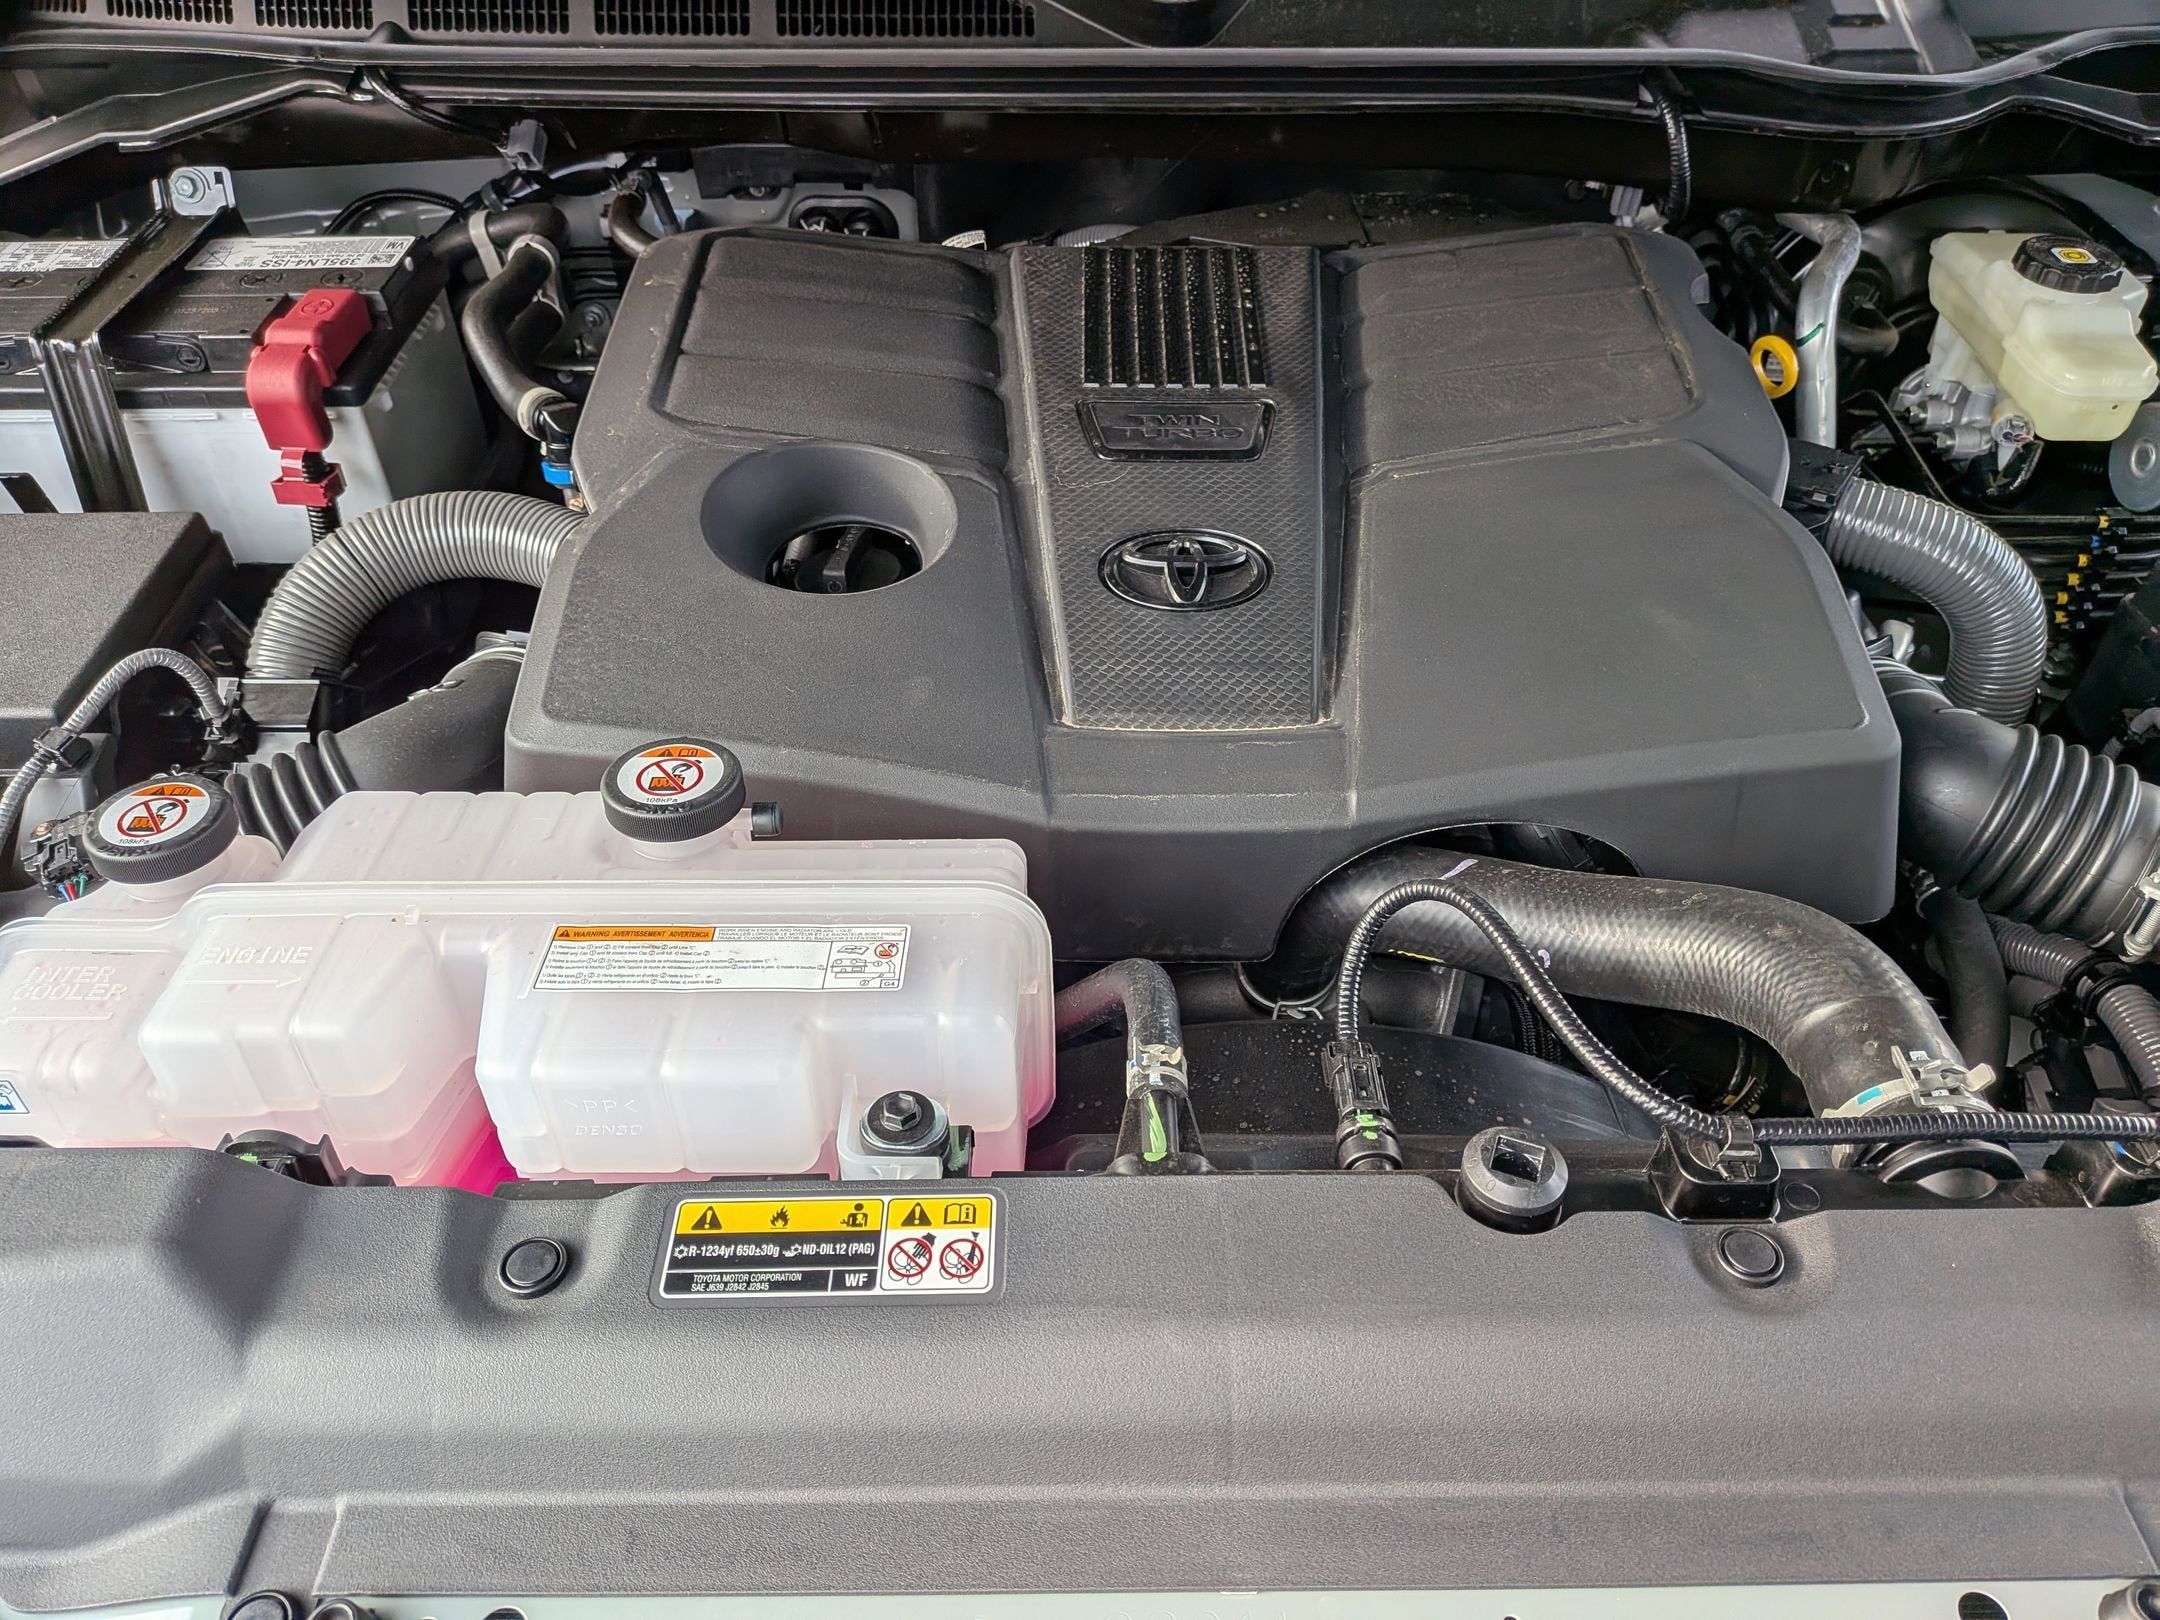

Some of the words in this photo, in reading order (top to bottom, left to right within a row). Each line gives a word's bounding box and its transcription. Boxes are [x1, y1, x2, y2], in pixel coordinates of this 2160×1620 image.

[259, 258, 361, 268] 395LN4-ISS
[1128, 414, 1220, 426] TWIN
[1111, 426, 1245, 439] TURBO
[573, 930, 610, 938] WARNING
[612, 930, 665, 938] AVERTISSEMENT
[668, 930, 709, 938] ADVERTENCIA
[199, 946, 313, 964] ENGINE
[24, 966, 116, 984] INTER
[12, 983, 128, 1001] COOLER
[575, 1124, 643, 1136] DENSO
[688, 1244, 735, 1258] R-1234yf
[736, 1244, 780, 1258] 650±30g
[802, 1243, 846, 1256] ND-OIL12
[848, 1242, 875, 1256] (PAG)
[693, 1274, 722, 1283] TOYOTA
[723, 1274, 749, 1282] MOTOR
[750, 1272, 802, 1282] CORPORATION
[844, 1273, 869, 1287] WF
[691, 1284, 705, 1292] SAE
[706, 1283, 724, 1292] J639
[725, 1282, 746, 1291] J2842
[747, 1282, 769, 1291] J2845
